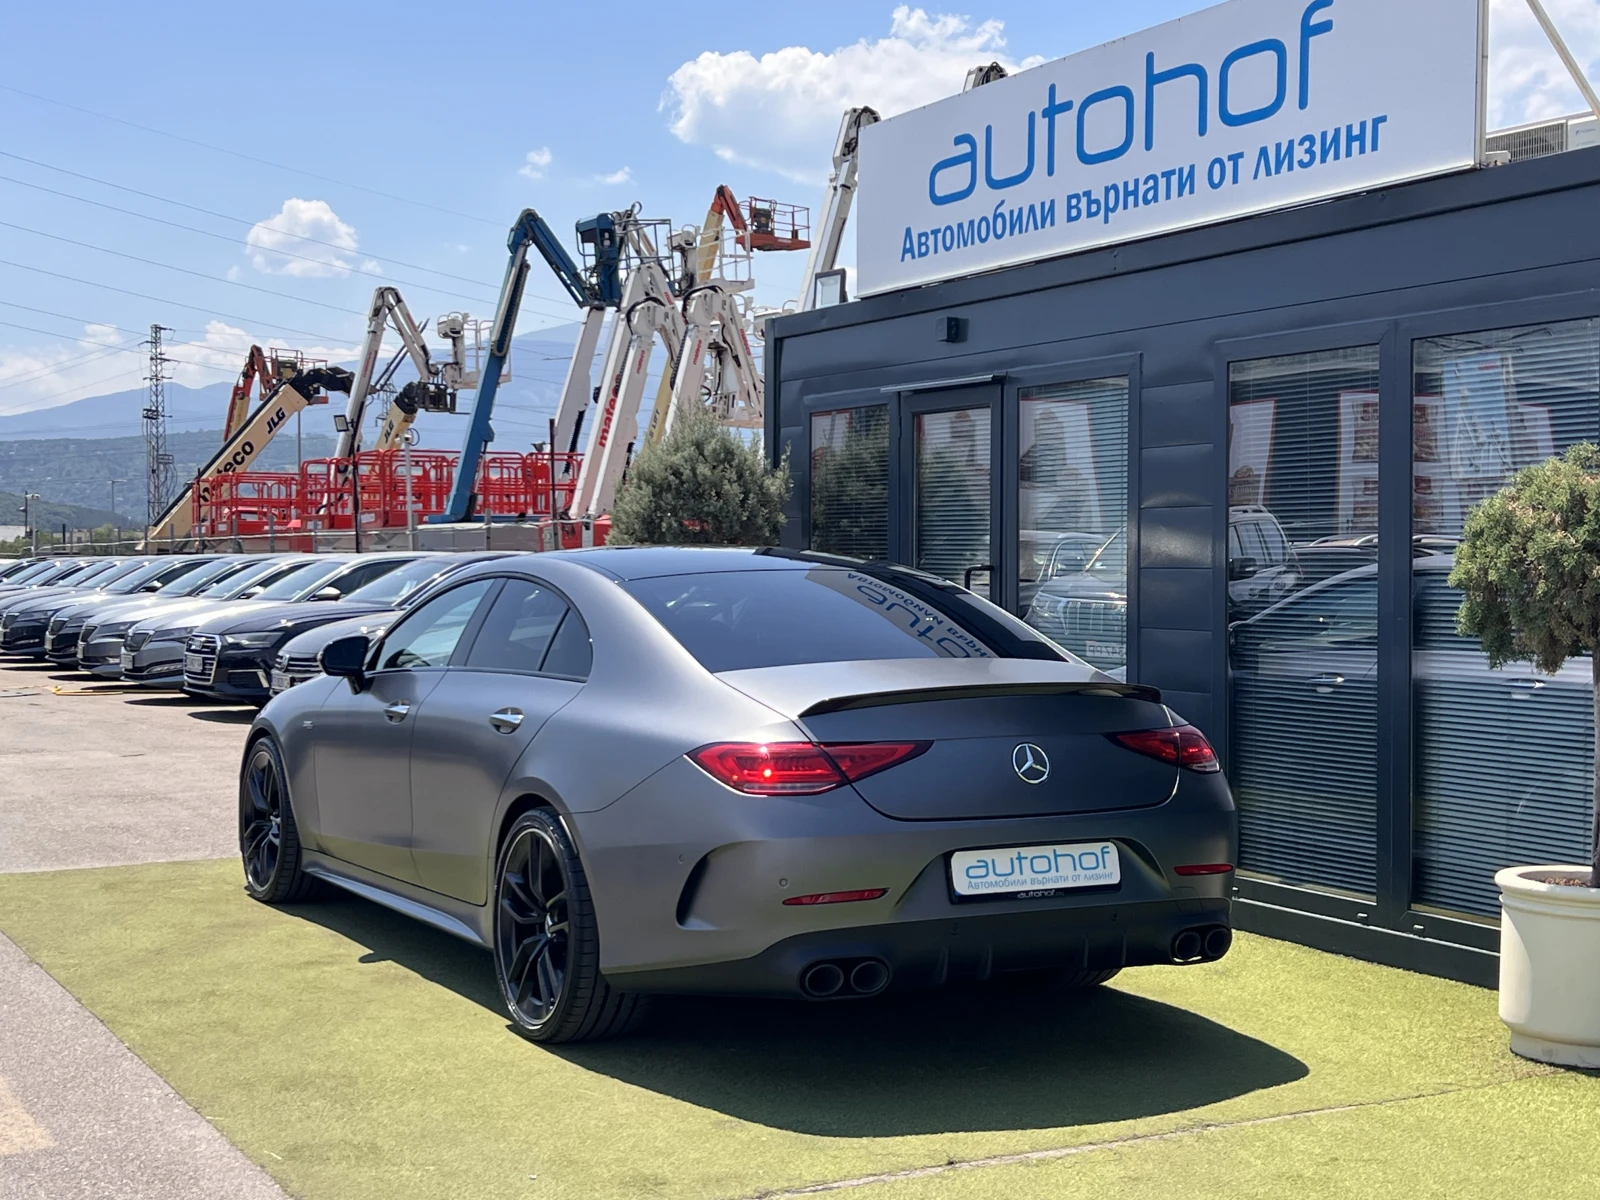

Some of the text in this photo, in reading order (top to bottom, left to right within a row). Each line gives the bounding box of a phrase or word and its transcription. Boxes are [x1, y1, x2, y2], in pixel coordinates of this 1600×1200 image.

[929, 0, 1334, 207] autohof
[901, 115, 1388, 263] Автомобили върнати от лизинг
[267, 407, 287, 435] JLG
[965, 846, 1110, 878] autohof
[967, 871, 1114, 890] Автомобили върнати от лизинг
